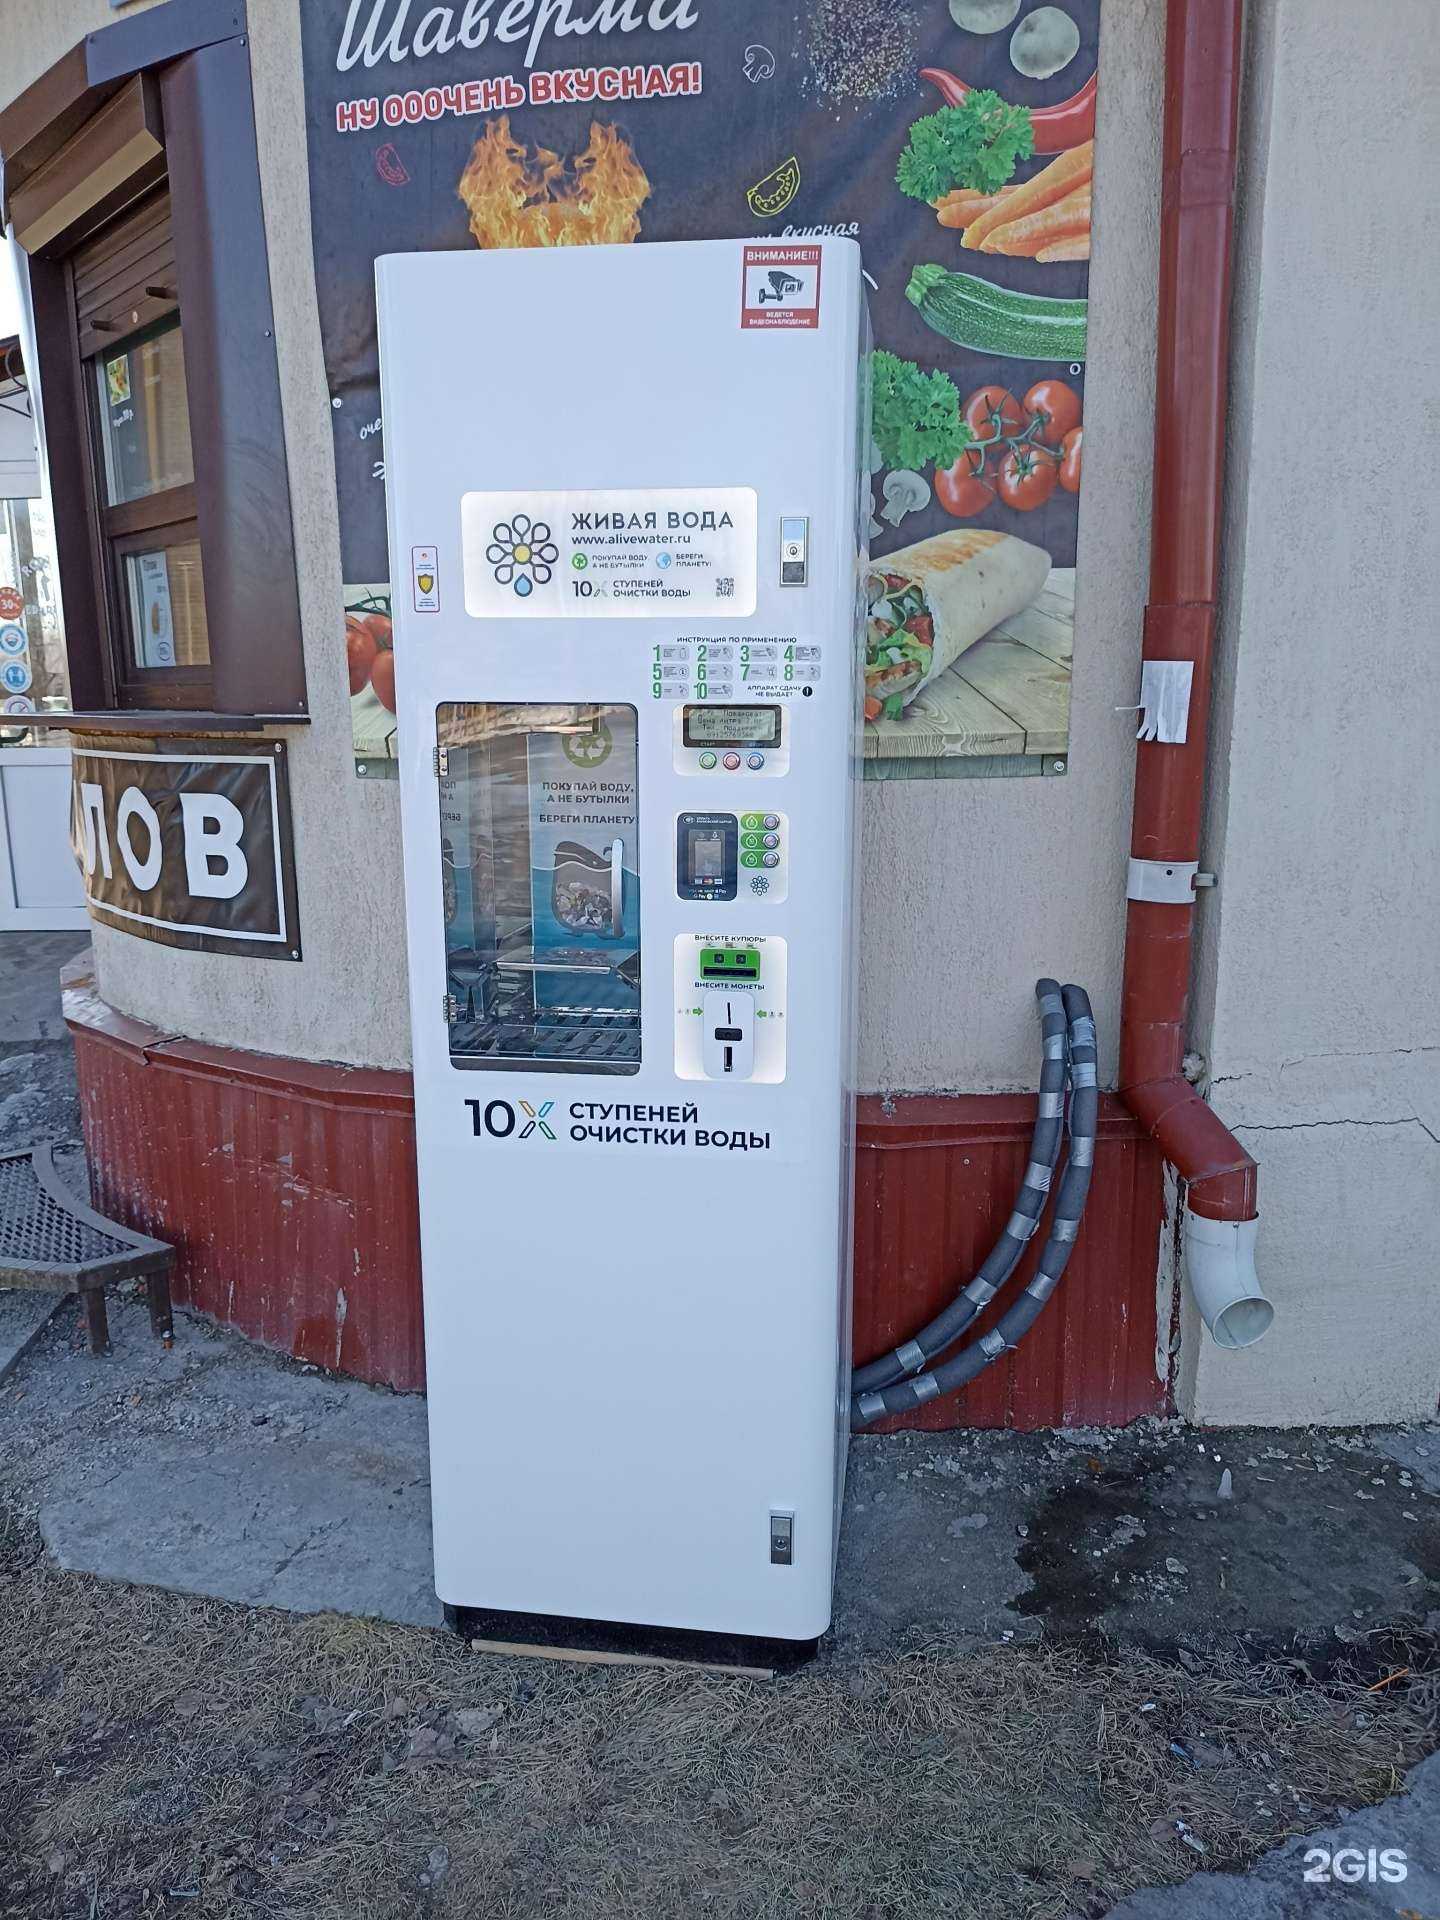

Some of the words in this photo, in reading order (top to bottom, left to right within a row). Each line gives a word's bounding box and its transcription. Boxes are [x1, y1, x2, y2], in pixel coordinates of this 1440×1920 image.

[336, 0, 699, 71] Шаверма
[337, 98, 379, 132] НУ
[383, 75, 525, 127] ОООЧЕНЬ
[529, 62, 702, 107] ВКУСНАЯ!
[746, 250, 819, 260] ВНИМАНИЕ!!!
[571, 512, 657, 530] ЖИВАЯ
[667, 511, 734, 531] ВОДА
[571, 534, 691, 545] www.alivewater.ru
[613, 578, 664, 588] СТУПЕНЕЙ
[613, 589, 659, 598] ОЧИСТКИ
[662, 589, 691, 598] ВОДЫ
[677, 636, 727, 644] ИНСТРУКЦИЯ
[653, 645, 661, 662] 1
[697, 645, 707, 662] 2
[740, 645, 750, 662] 3
[783, 645, 795, 662] 4
[653, 663, 662, 680] 5
[697, 663, 707, 680] 6
[740, 663, 751, 681] 7
[783, 664, 794, 681] 8
[653, 682, 662, 699] 9
[694, 682, 707, 699] 10
[543, 781, 597, 792] ПОКУПАЙ
[600, 783, 635, 793] ВОДУ,
[547, 794, 554, 803] А
[558, 795, 573, 803] НЕ
[576, 795, 630, 804] БУТЫЛКИ
[540, 814, 580, 824] БЕРЕГИ
[72, 778, 249, 900] ЛОВ
[569, 1102, 699, 1124] СТУПЕНЕЙ
[569, 1125, 687, 1145] ОЧИСТКИ
[695, 1130, 771, 1151] ВОДЫ
